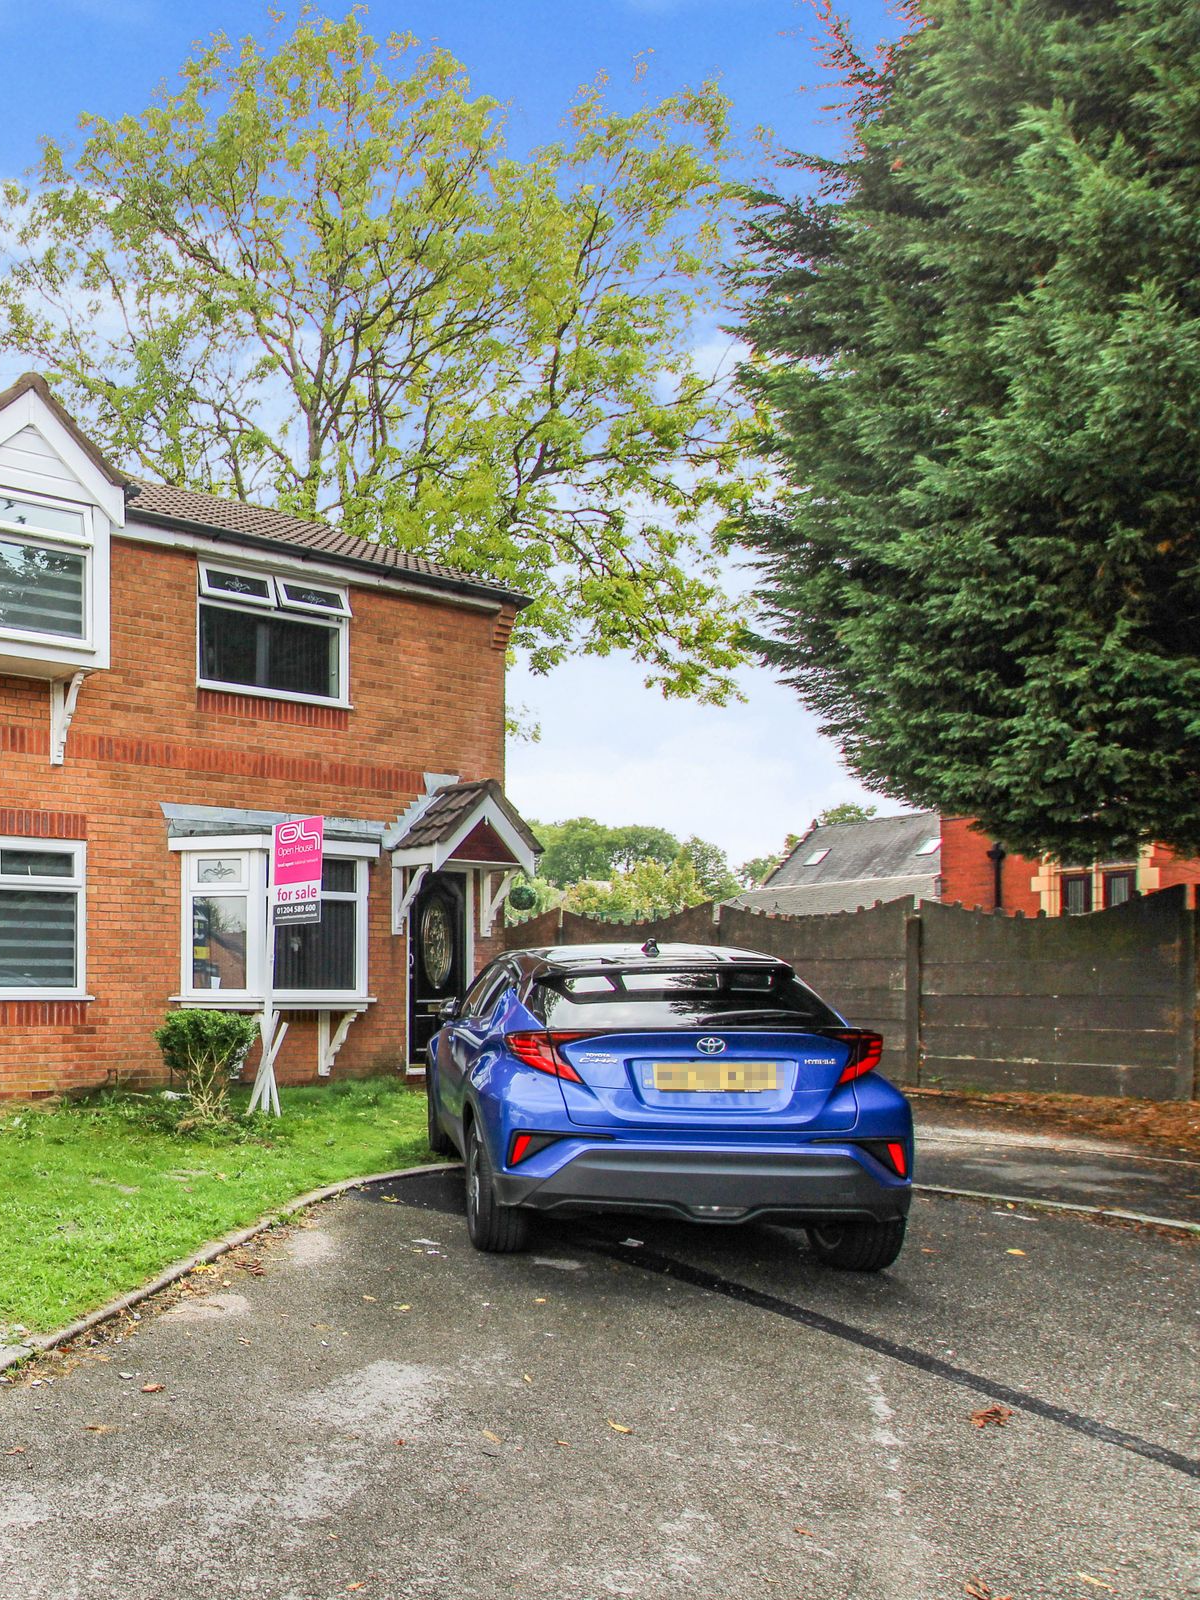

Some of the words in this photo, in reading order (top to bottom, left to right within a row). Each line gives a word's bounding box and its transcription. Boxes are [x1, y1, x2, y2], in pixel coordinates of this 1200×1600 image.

[277, 847, 294, 858] Open
[295, 844, 313, 854] House
[277, 888, 293, 902] for
[295, 885, 317, 900] sale
[276, 906, 293, 915] 01204
[294, 905, 304, 913] 589
[305, 904, 316, 912] 600
